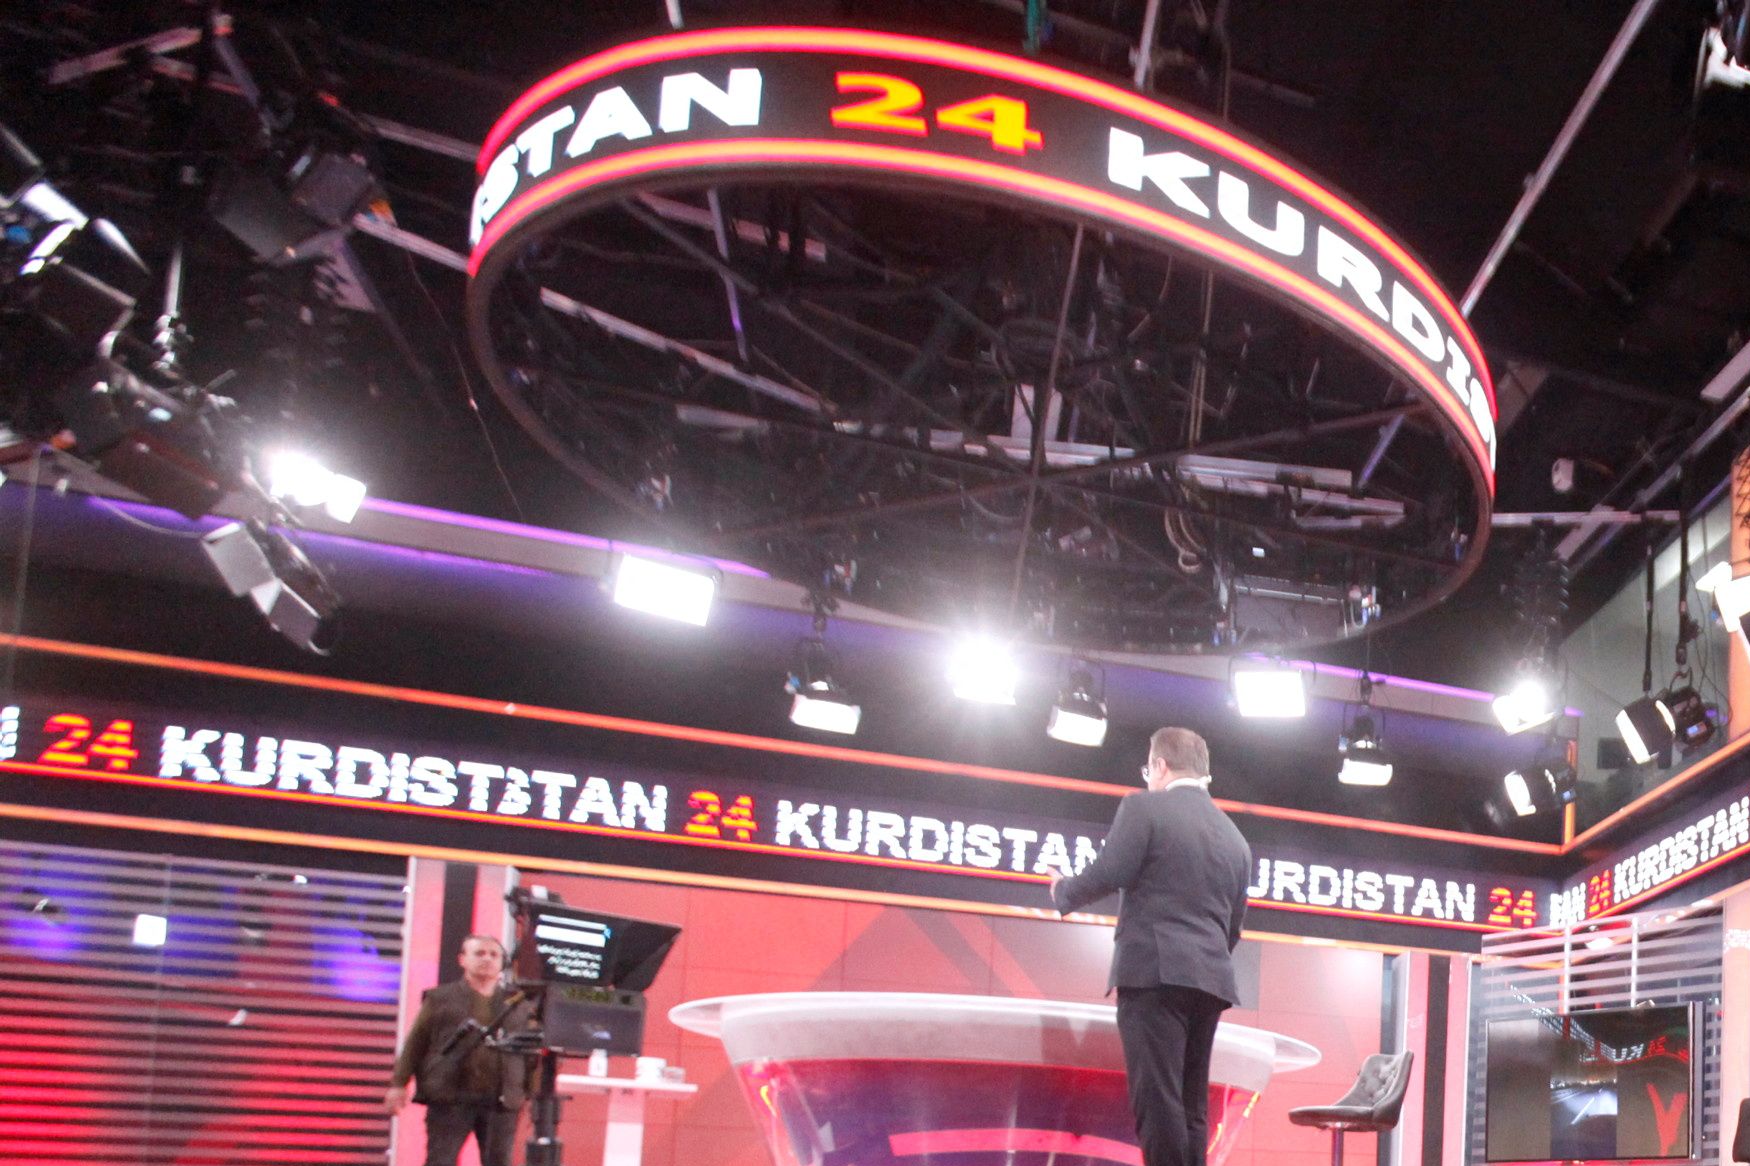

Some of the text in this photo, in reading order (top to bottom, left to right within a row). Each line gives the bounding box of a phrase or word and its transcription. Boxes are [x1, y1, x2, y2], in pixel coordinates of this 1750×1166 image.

[830, 71, 1043, 156] 24
[1107, 126, 1498, 473] KURDIS
[38, 713, 140, 769] 24
[683, 790, 758, 843] 24
[1487, 887, 1538, 927] 24
[1588, 869, 1613, 916] 24
[1613, 796, 1750, 904] KURDISTAN
